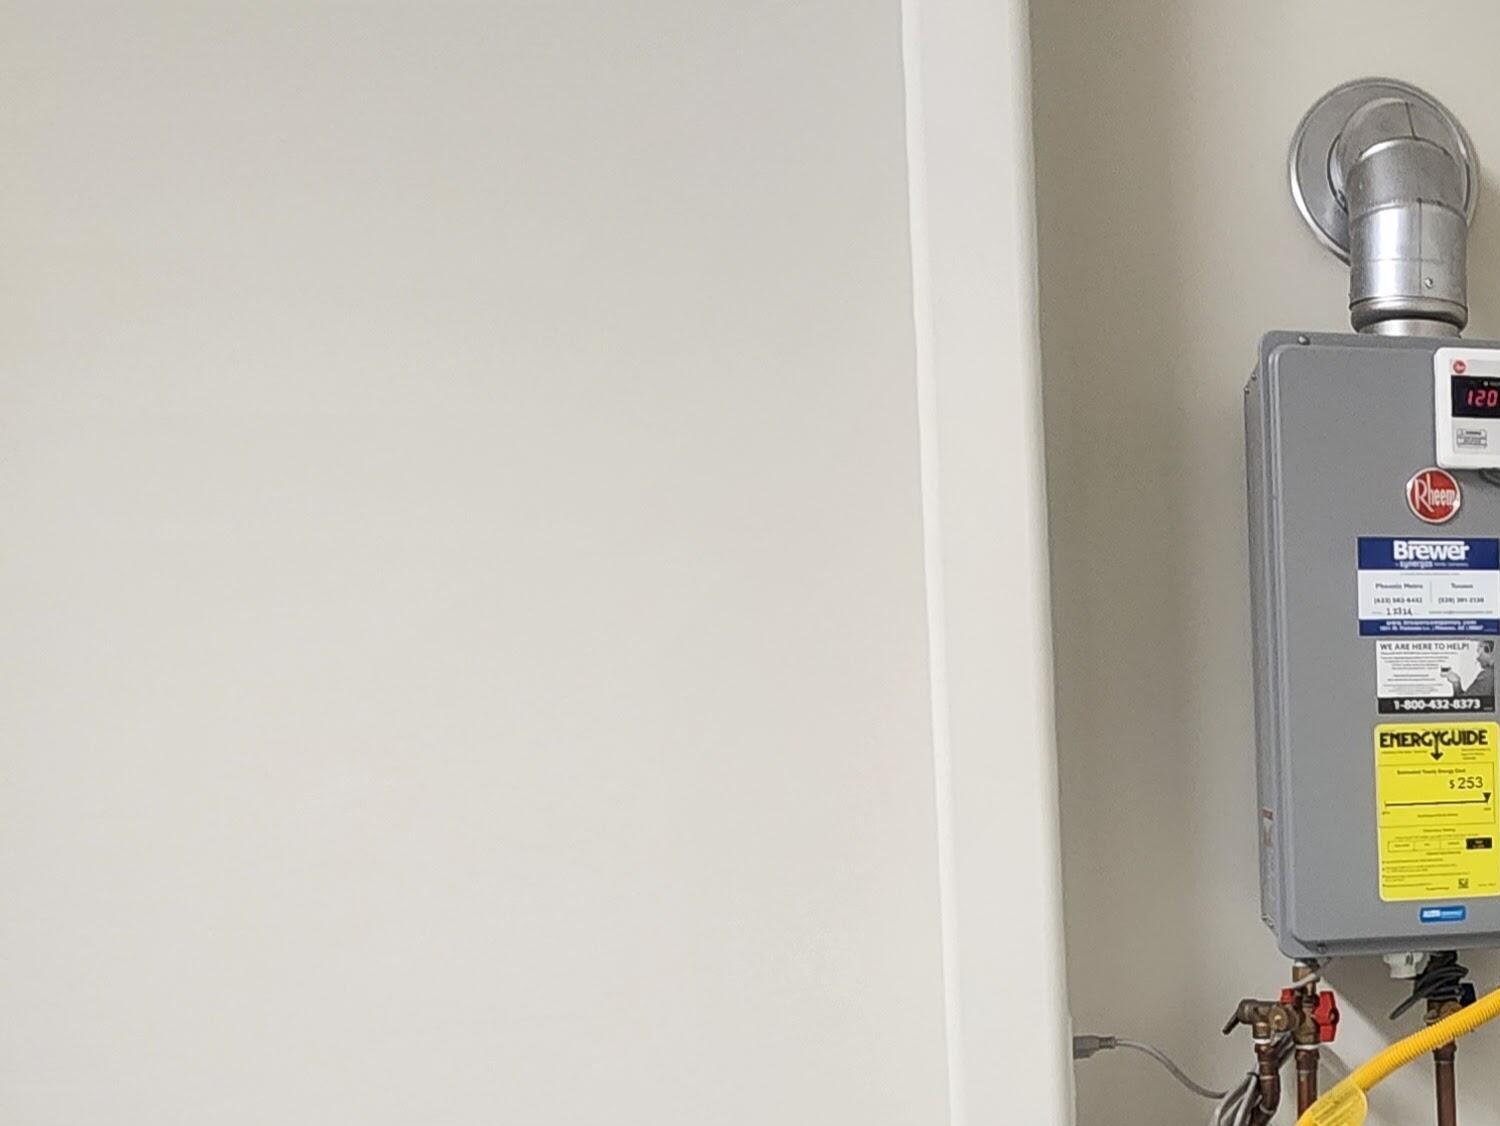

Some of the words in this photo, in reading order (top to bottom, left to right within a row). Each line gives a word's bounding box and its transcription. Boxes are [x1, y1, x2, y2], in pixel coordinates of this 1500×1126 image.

[1467, 389, 1499, 408] 120
[1414, 473, 1456, 513] Rheem
[1393, 540, 1470, 560] Brewer
[1380, 643, 1392, 651] WE
[1393, 699, 1481, 710] 1-800-432-8373
[1379, 729, 1488, 749] ENERGYGUIDE
[1457, 776, 1483, 789] 253
